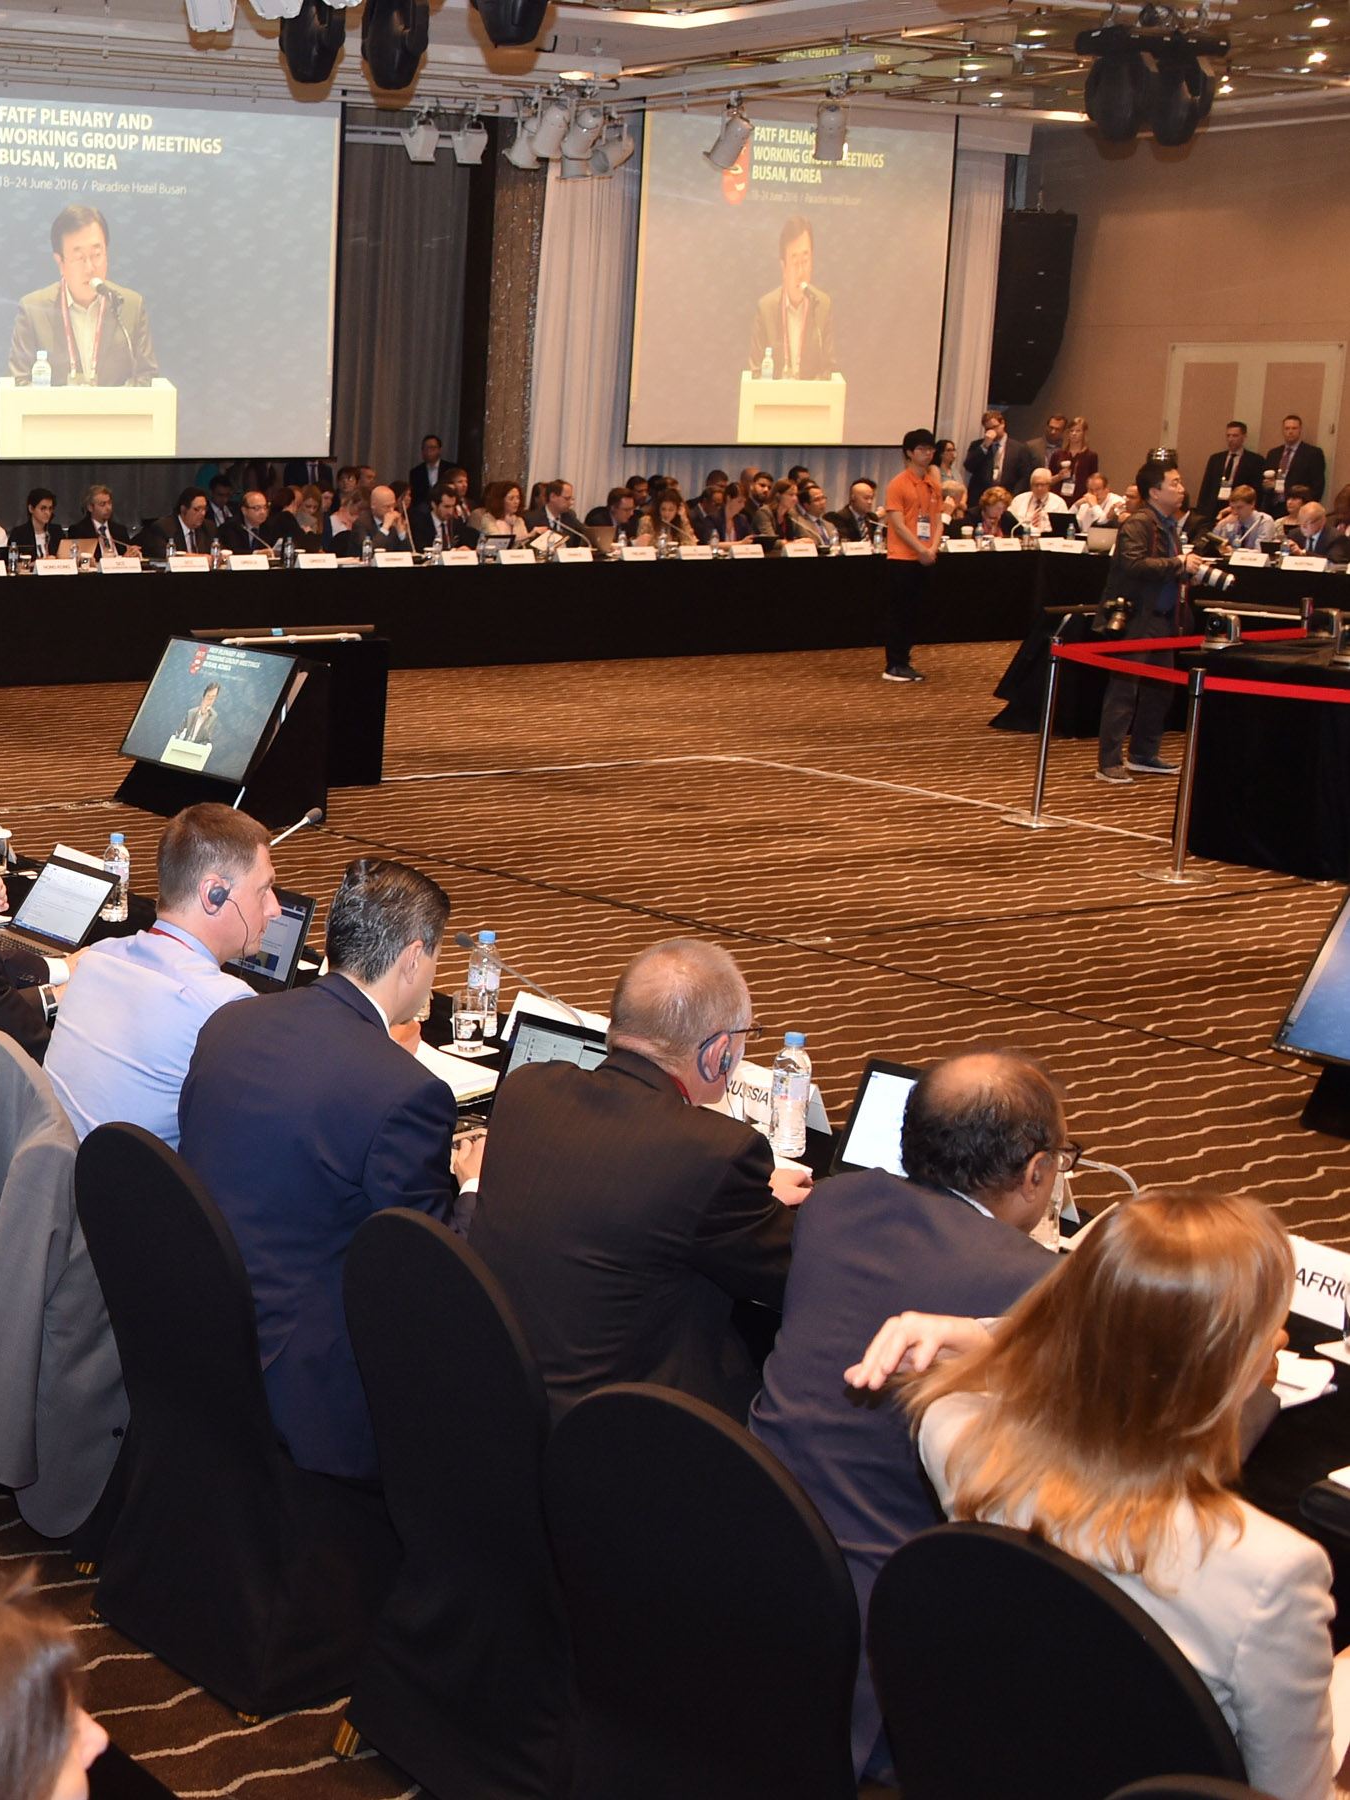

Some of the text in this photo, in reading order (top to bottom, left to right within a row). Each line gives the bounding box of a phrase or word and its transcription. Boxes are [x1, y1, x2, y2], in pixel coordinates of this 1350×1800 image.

[40, 108, 115, 129] PLENARY
[117, 112, 153, 130] AND
[81, 132, 138, 150] GROUP
[141, 135, 223, 154] MEETINGS
[753, 126, 777, 142] FATF
[63, 151, 118, 170] KOREA
[753, 146, 800, 163] WORKING
[752, 165, 822, 184] BUSAN, KOREA
[29, 177, 54, 190] June
[55, 178, 79, 191] 2016
[91, 180, 131, 193] Paradise
[132, 181, 157, 194] Hotel
[159, 183, 187, 195] Busan
